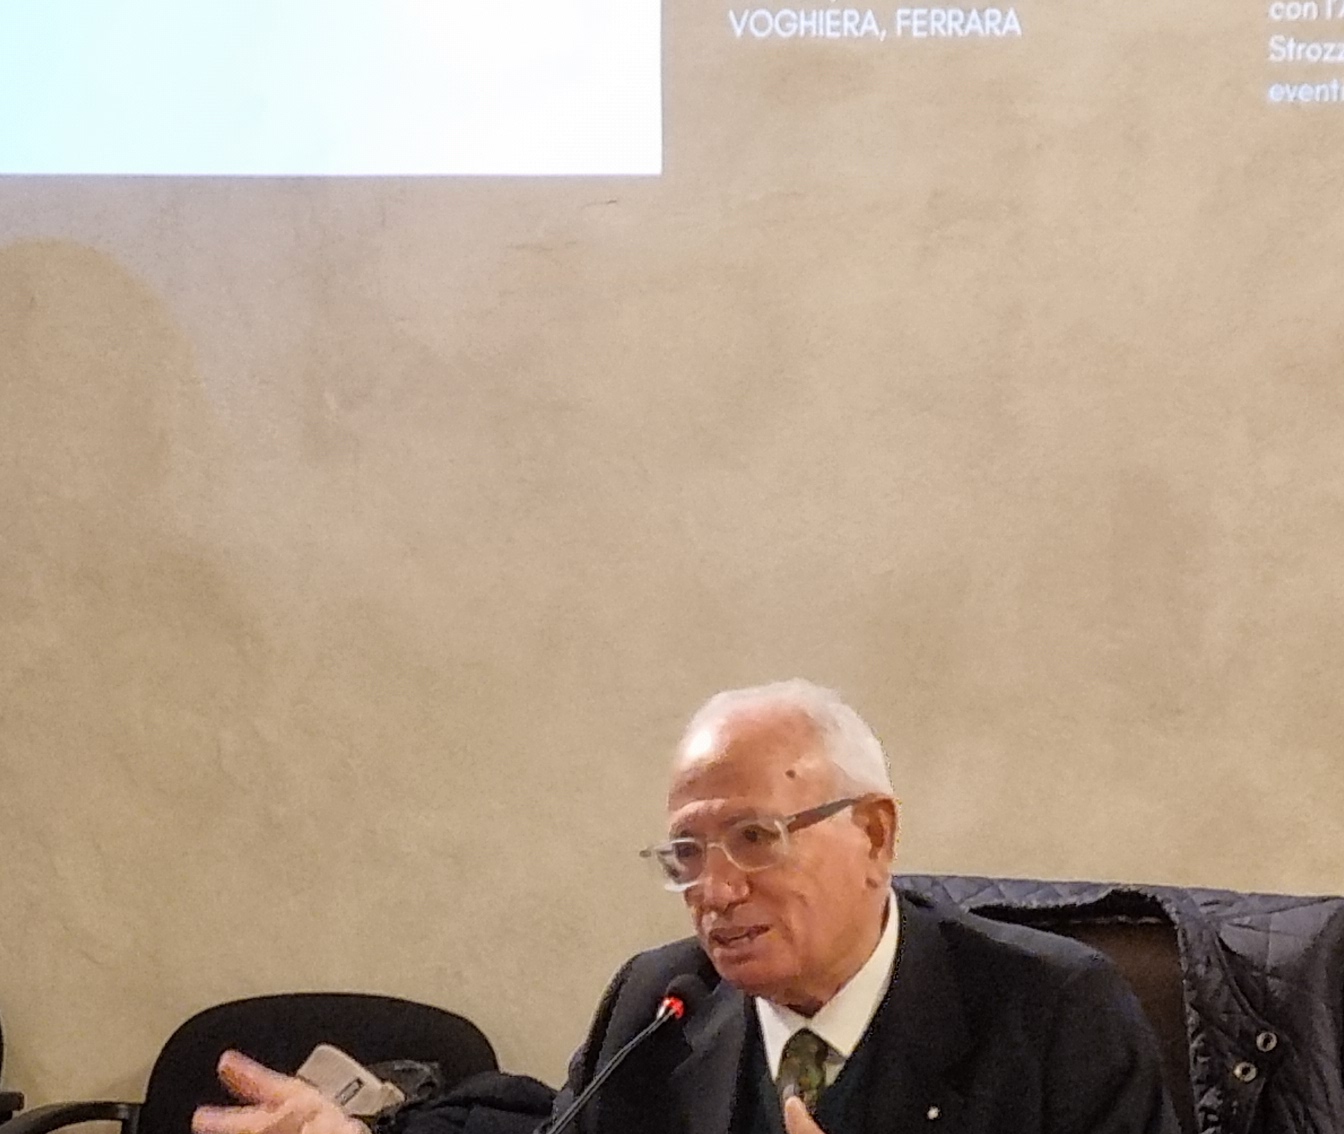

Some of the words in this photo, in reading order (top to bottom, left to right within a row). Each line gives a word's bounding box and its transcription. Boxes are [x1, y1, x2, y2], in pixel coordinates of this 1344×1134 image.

[1269, 0, 1318, 20] con
[728, 8, 887, 41] VOGHIERA,
[896, 8, 1022, 37] FERRARA
